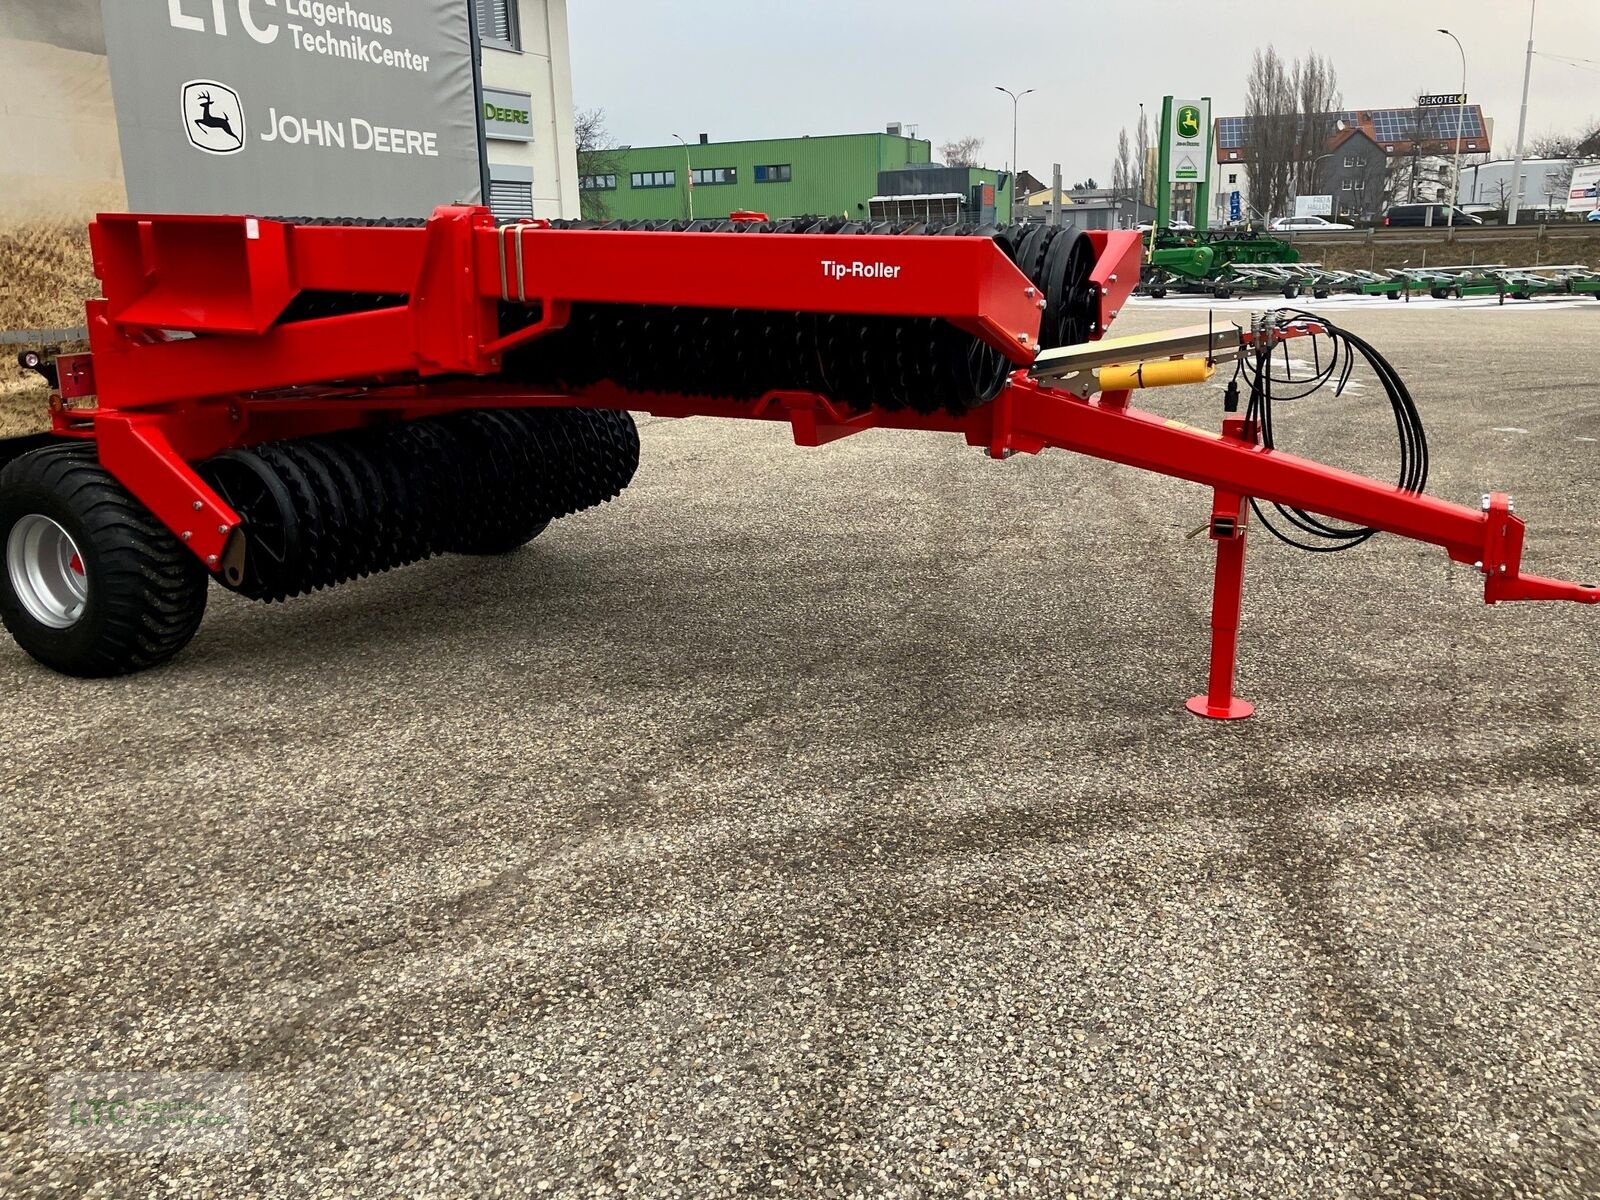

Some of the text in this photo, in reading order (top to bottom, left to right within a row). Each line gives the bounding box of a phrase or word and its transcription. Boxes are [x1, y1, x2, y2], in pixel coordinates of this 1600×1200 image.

[285, 0, 393, 35] Lagerhaus
[287, 23, 430, 72] TechnikCenter
[485, 103, 529, 124] DEERE
[260, 107, 439, 156] JOHN DEERE
[821, 260, 901, 280] Tip-Roller
